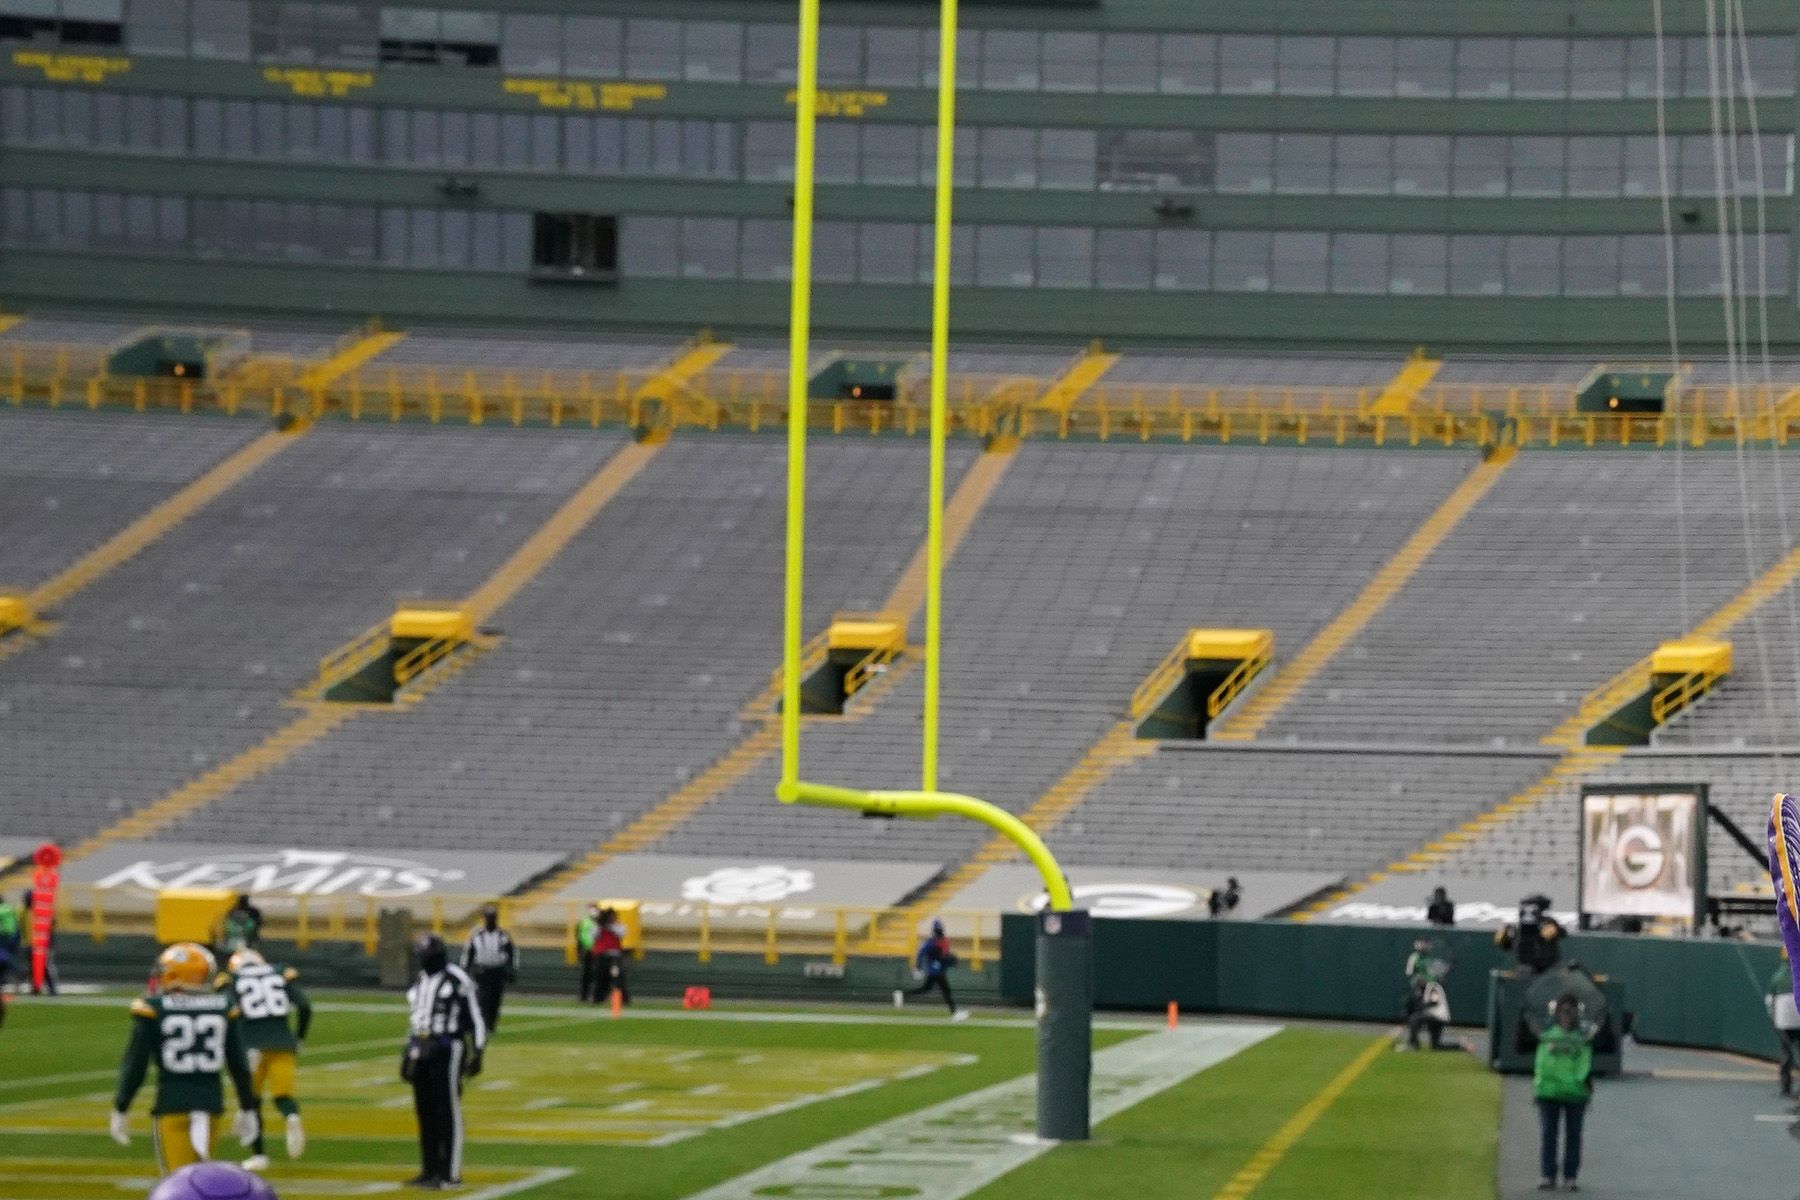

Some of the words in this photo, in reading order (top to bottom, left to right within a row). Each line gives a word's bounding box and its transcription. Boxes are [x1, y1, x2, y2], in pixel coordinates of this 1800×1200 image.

[1615, 824, 1664, 888] G
[235, 973, 290, 1018] 26
[160, 1013, 227, 1073] 23
